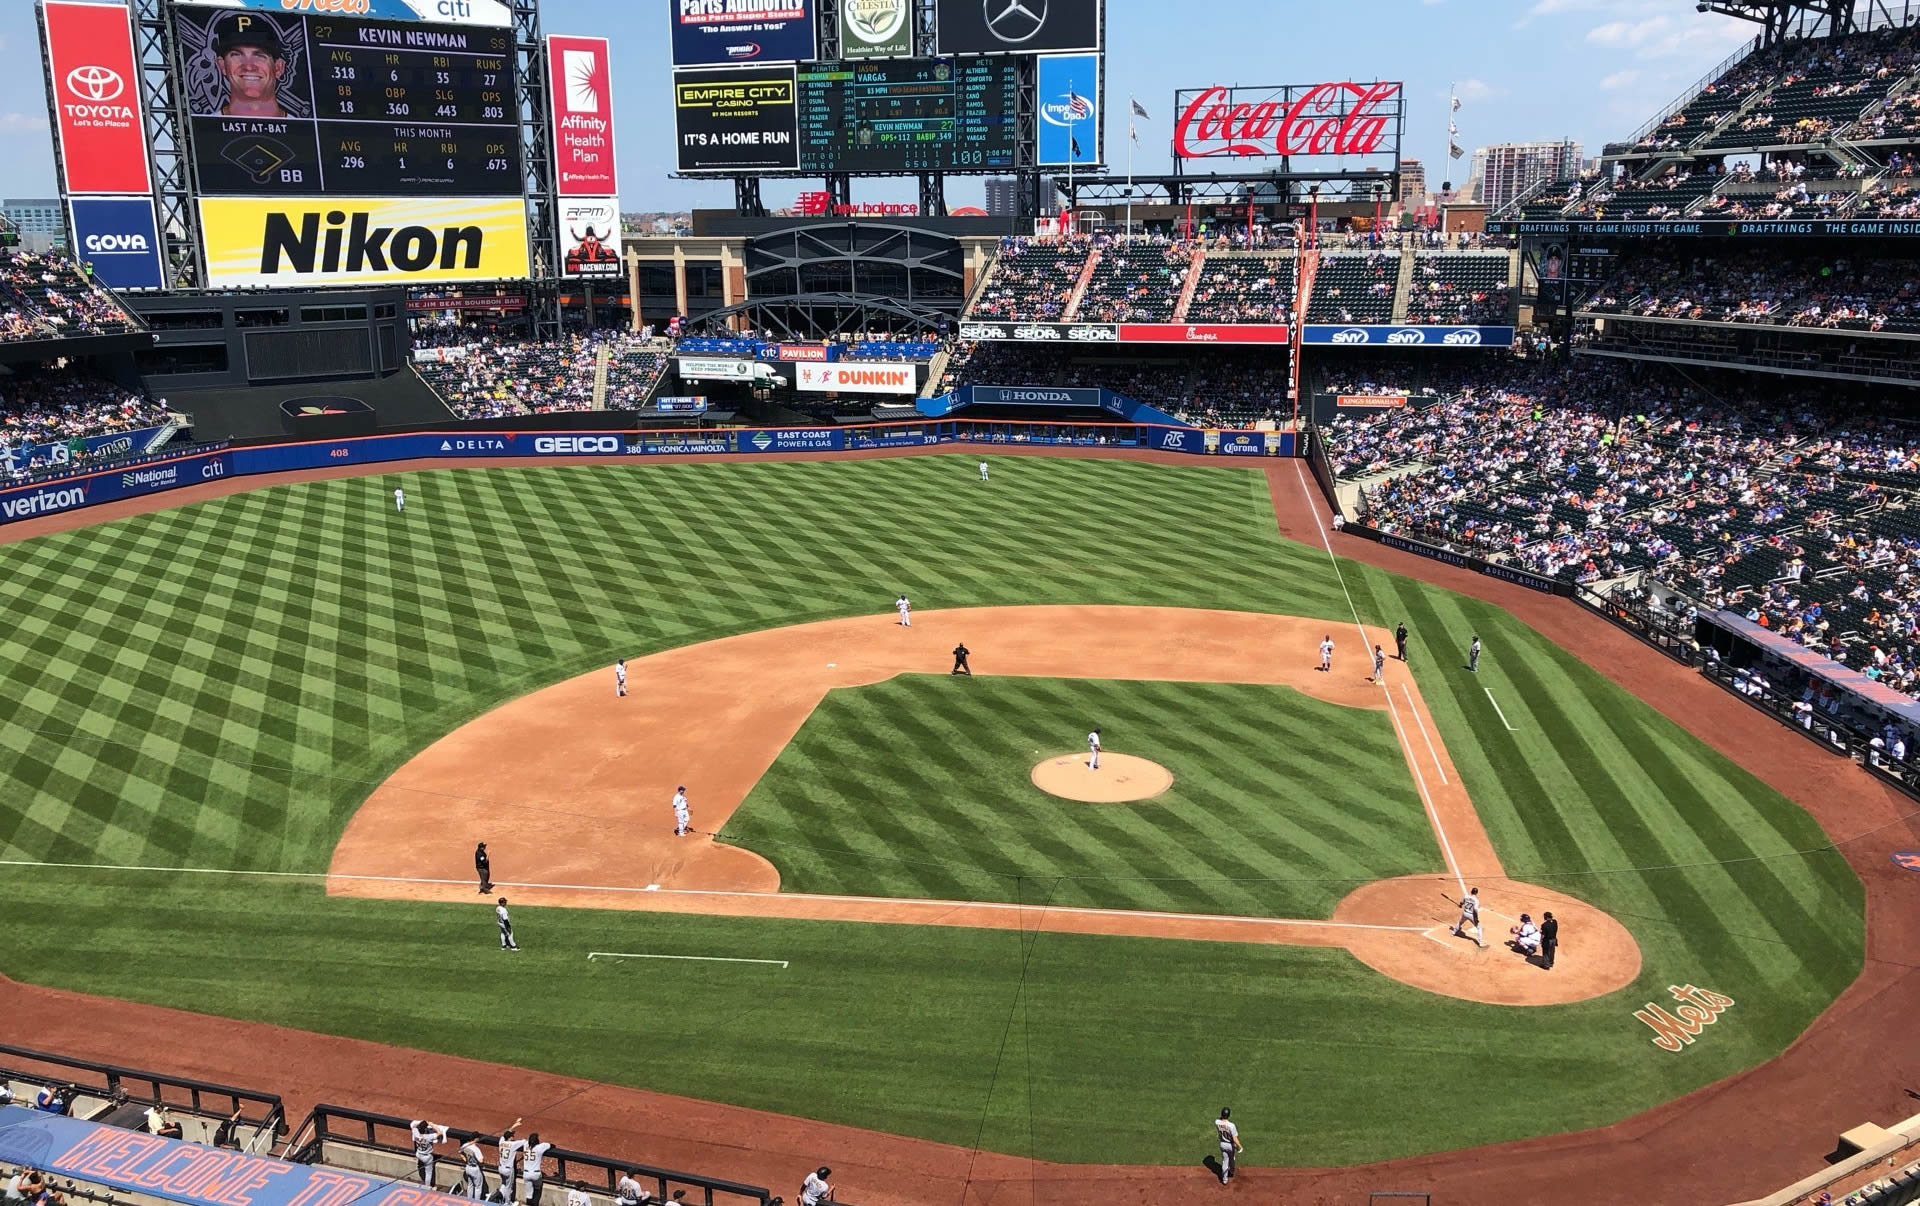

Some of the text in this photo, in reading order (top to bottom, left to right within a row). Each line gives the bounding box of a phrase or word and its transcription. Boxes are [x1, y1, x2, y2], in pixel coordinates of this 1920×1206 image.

[681, 0, 723, 16] Parts
[708, 14, 735, 22] Parts
[315, 26, 332, 38] 27
[359, 28, 466, 48] KEVIN NEWMAN
[847, 46, 873, 54] Healthier
[874, 45, 885, 54] Way
[332, 52, 501, 70] AVG HR RBI RUNS
[331, 67, 496, 85] .318 6 35 27
[857, 73, 887, 82] VARGAS
[917, 71, 928, 80] 44
[339, 86, 500, 101] BB OBP SLG OPS
[684, 87, 785, 100] EMPIRE CITY
[64, 104, 134, 119] TOYOTA
[340, 102, 503, 118] 18 .360 .443 .803
[74, 119, 91, 127] Let's
[105, 120, 130, 128] Places
[222, 122, 287, 133] LAST AT-BAT
[561, 115, 607, 133] Affinity
[941, 121, 953, 130] 27
[394, 128, 451, 139] THIS MONTH
[684, 131, 790, 146] IT'S A HOME RUN
[898, 133, 910, 141] 112
[564, 133, 605, 148] Health
[341, 141, 504, 154] AVG HR RBI OPS
[572, 148, 599, 163] Plan
[341, 157, 507, 170] .296 1 6 .675
[281, 169, 302, 182] BB
[863, 201, 918, 214] balance
[1520, 224, 1571, 233] DRAFTKINGS
[1578, 224, 1593, 233] THE
[1596, 224, 1619, 233] GAME
[1621, 224, 1650, 233] INSIDE
[1654, 224, 1670, 233] THE
[1742, 223, 1812, 233] DRAFTKINGS
[1826, 223, 1847, 233] THE
[1851, 223, 1884, 233] GAME
[86, 234, 147, 251] GOYA
[261, 210, 484, 274] Nikon
[568, 263, 618, 272] RPMRACEWAY.COM
[1332, 331, 1365, 343] SNY
[1387, 331, 1421, 343] SNY
[1443, 331, 1478, 343] SNY
[782, 348, 824, 359] PAVILION
[838, 370, 909, 385] DUNKIN'
[1014, 392, 1072, 401] HONDA
[456, 440, 504, 450] DELTA
[535, 436, 619, 453] GEICO
[777, 440, 807, 448] POWER
[923, 436, 937, 444] 370
[1163, 431, 1185, 447] RTS
[330, 448, 349, 458] 408
[626, 446, 642, 454] 380
[657, 444, 726, 453] KONICA MINOLTA
[1224, 443, 1258, 454] Corona
[135, 466, 177, 484] National
[202, 460, 224, 478] citi
[160, 477, 176, 486] Rental
[2, 487, 85, 518] verizon
[1632, 983, 1736, 1052] Mets
[53, 1127, 293, 1204] WELCOME
